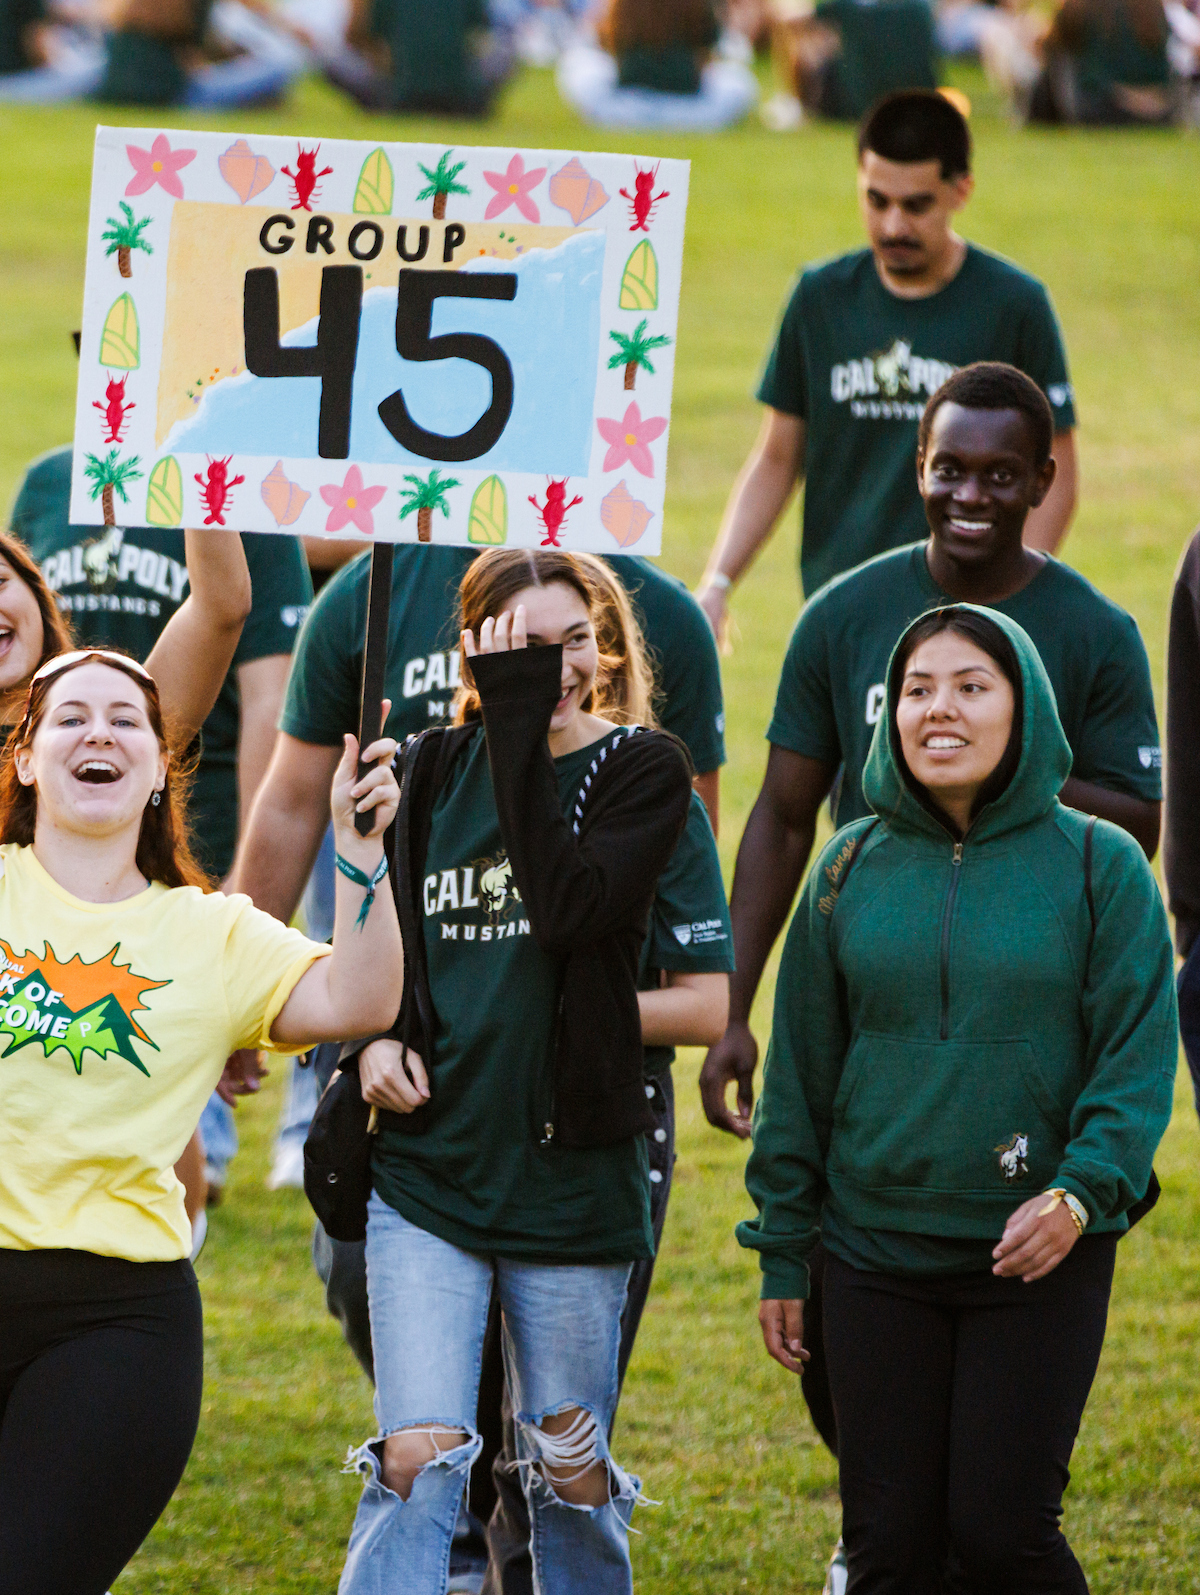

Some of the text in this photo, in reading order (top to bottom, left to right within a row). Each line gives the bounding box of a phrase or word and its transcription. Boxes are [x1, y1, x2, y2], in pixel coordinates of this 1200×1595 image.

[259, 213, 466, 263] GROUP
[243, 264, 519, 462] 45
[41, 543, 190, 601] CAL POLY
[402, 650, 464, 699] CAL
[423, 866, 479, 917] CAL
[440, 918, 531, 942] MUSTAN
[24, 981, 65, 1008] OF
